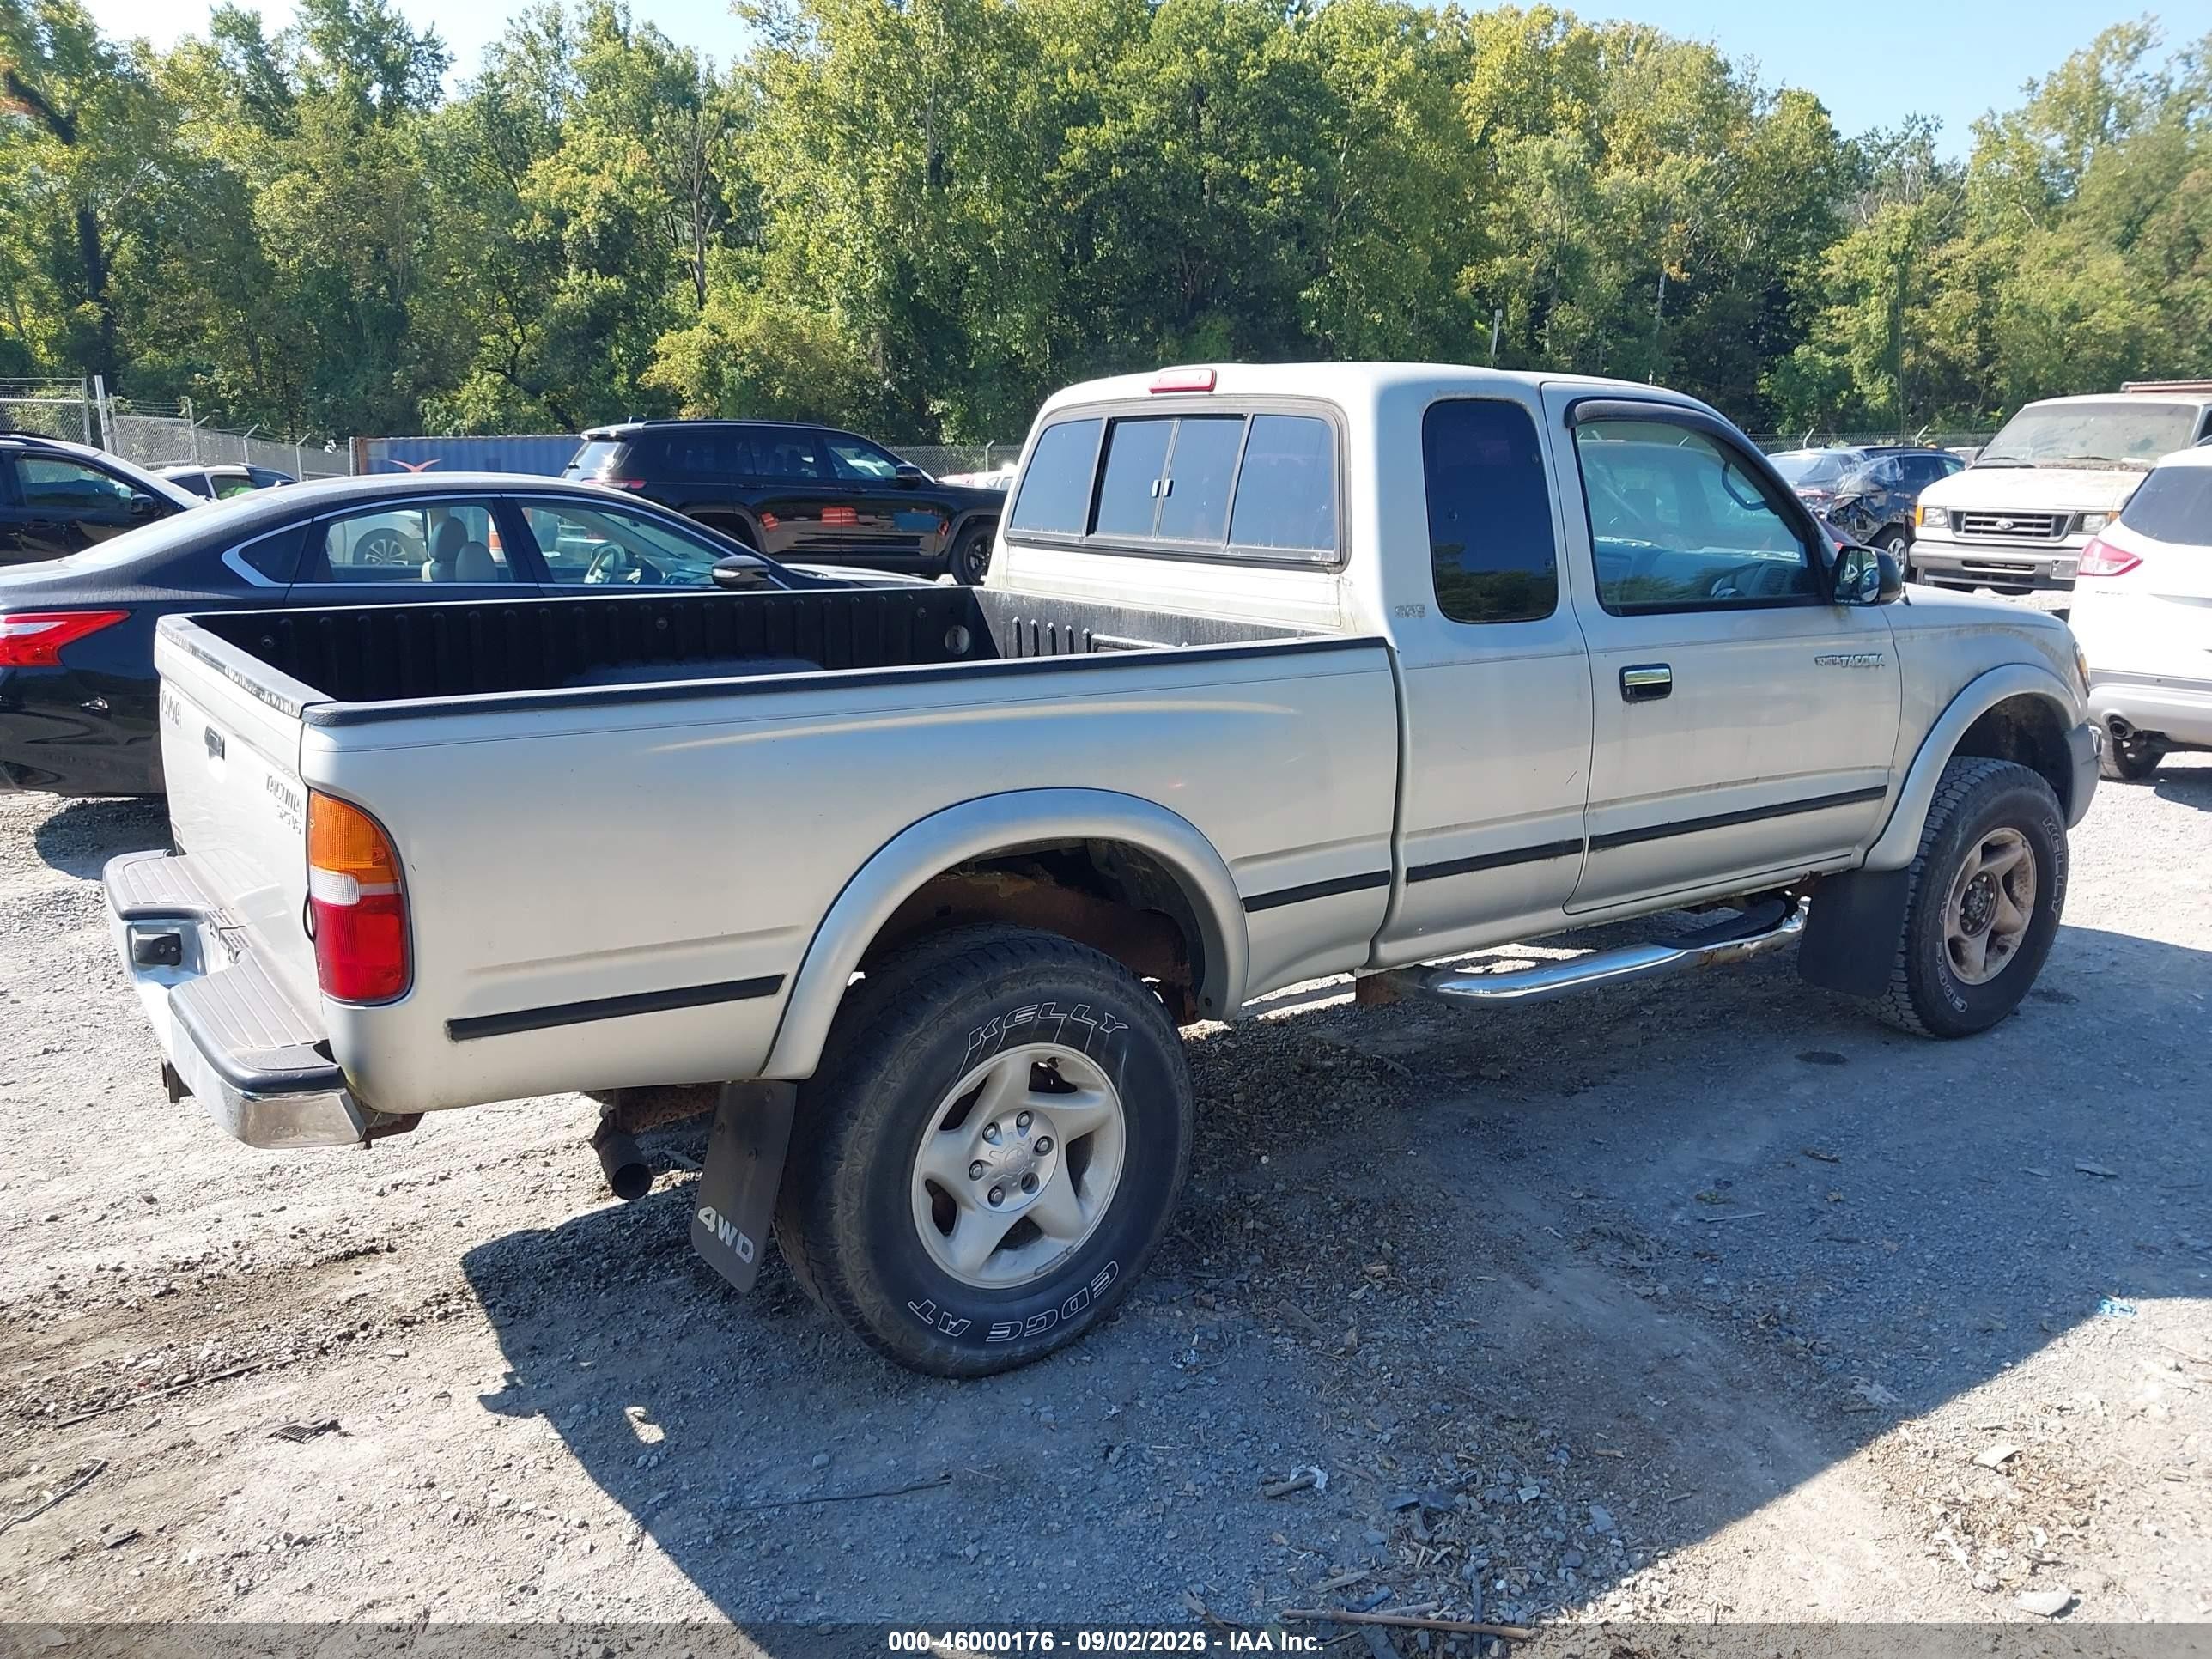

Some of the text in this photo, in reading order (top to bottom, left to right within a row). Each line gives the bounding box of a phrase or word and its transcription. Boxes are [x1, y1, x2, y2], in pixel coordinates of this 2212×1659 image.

[2042, 815, 2064, 921] KELLY
[968, 1001, 1130, 1051] KELLY
[697, 1205, 756, 1264] 4WD
[907, 1260, 1120, 1343] EDGE AT
